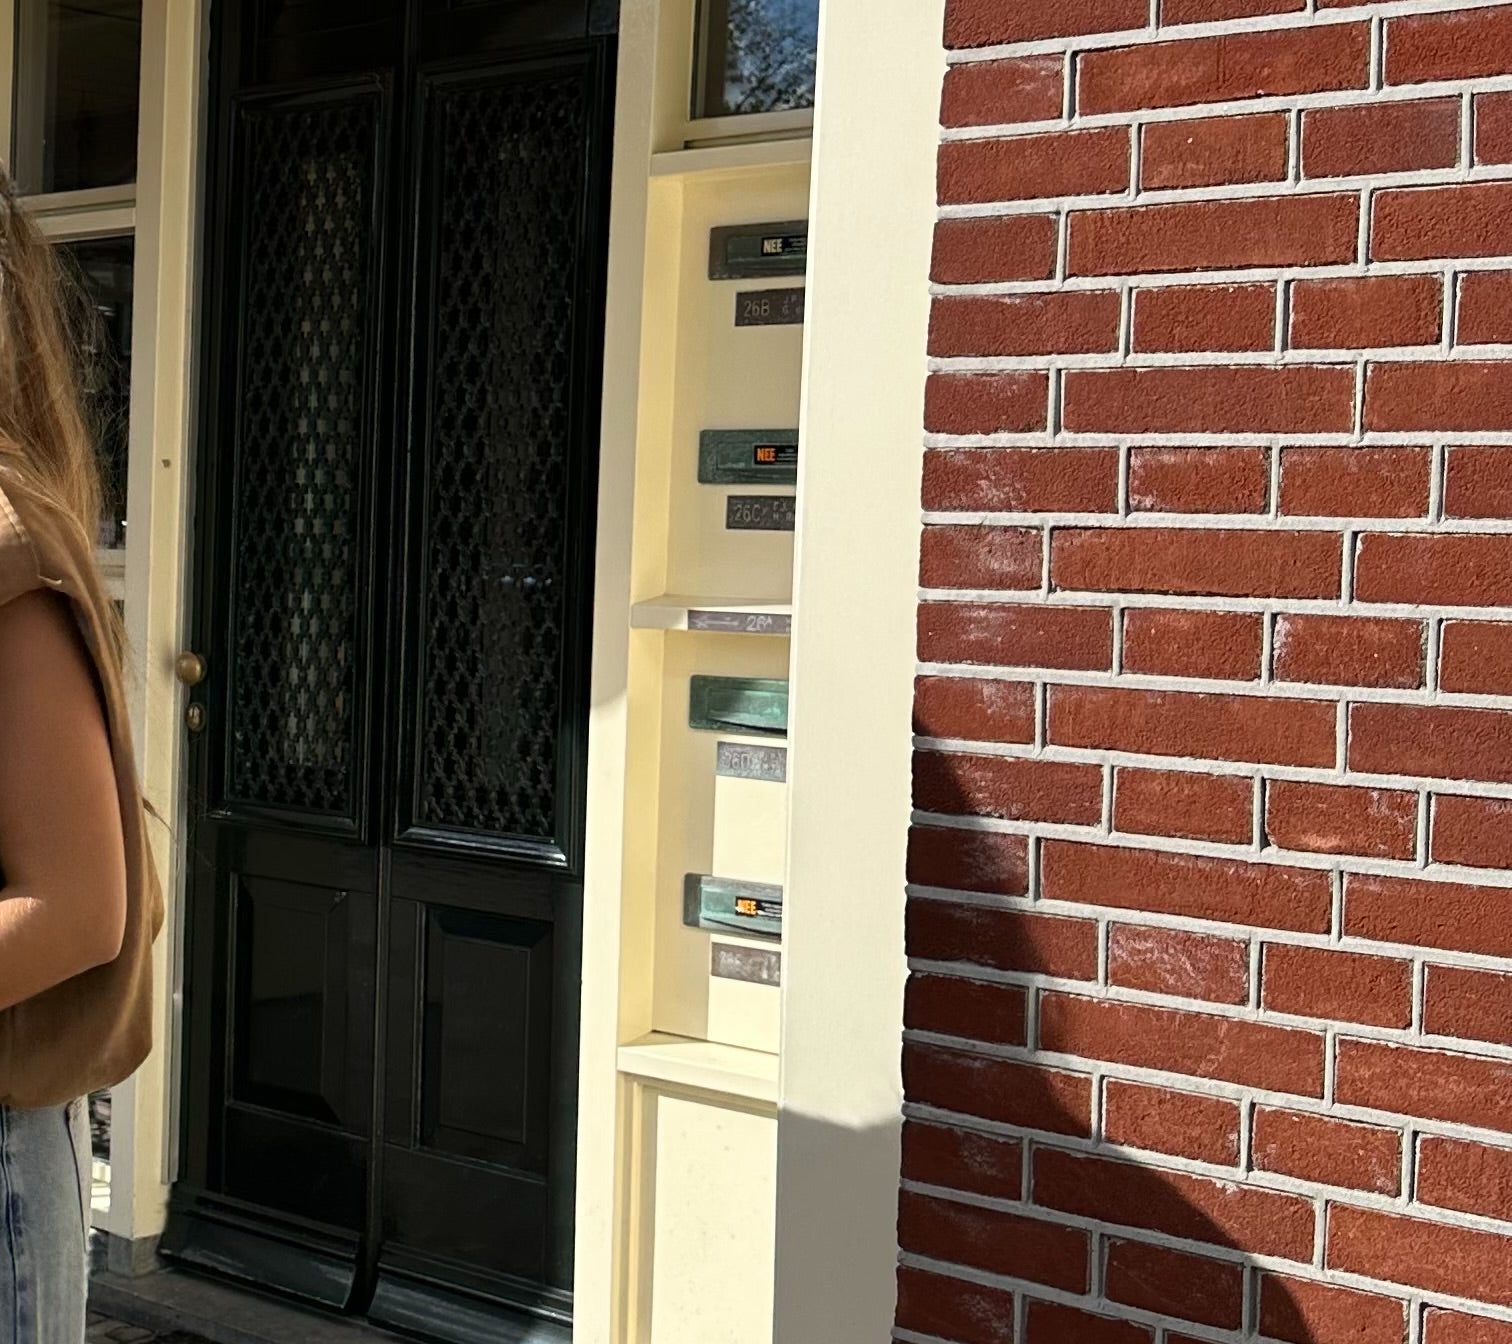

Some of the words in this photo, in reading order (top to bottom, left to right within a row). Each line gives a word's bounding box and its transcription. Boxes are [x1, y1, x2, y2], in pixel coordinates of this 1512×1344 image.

[763, 238, 783, 254] NEE
[743, 299, 770, 318] 26B
[756, 447, 777, 462] NEE
[734, 503, 761, 522] 26C
